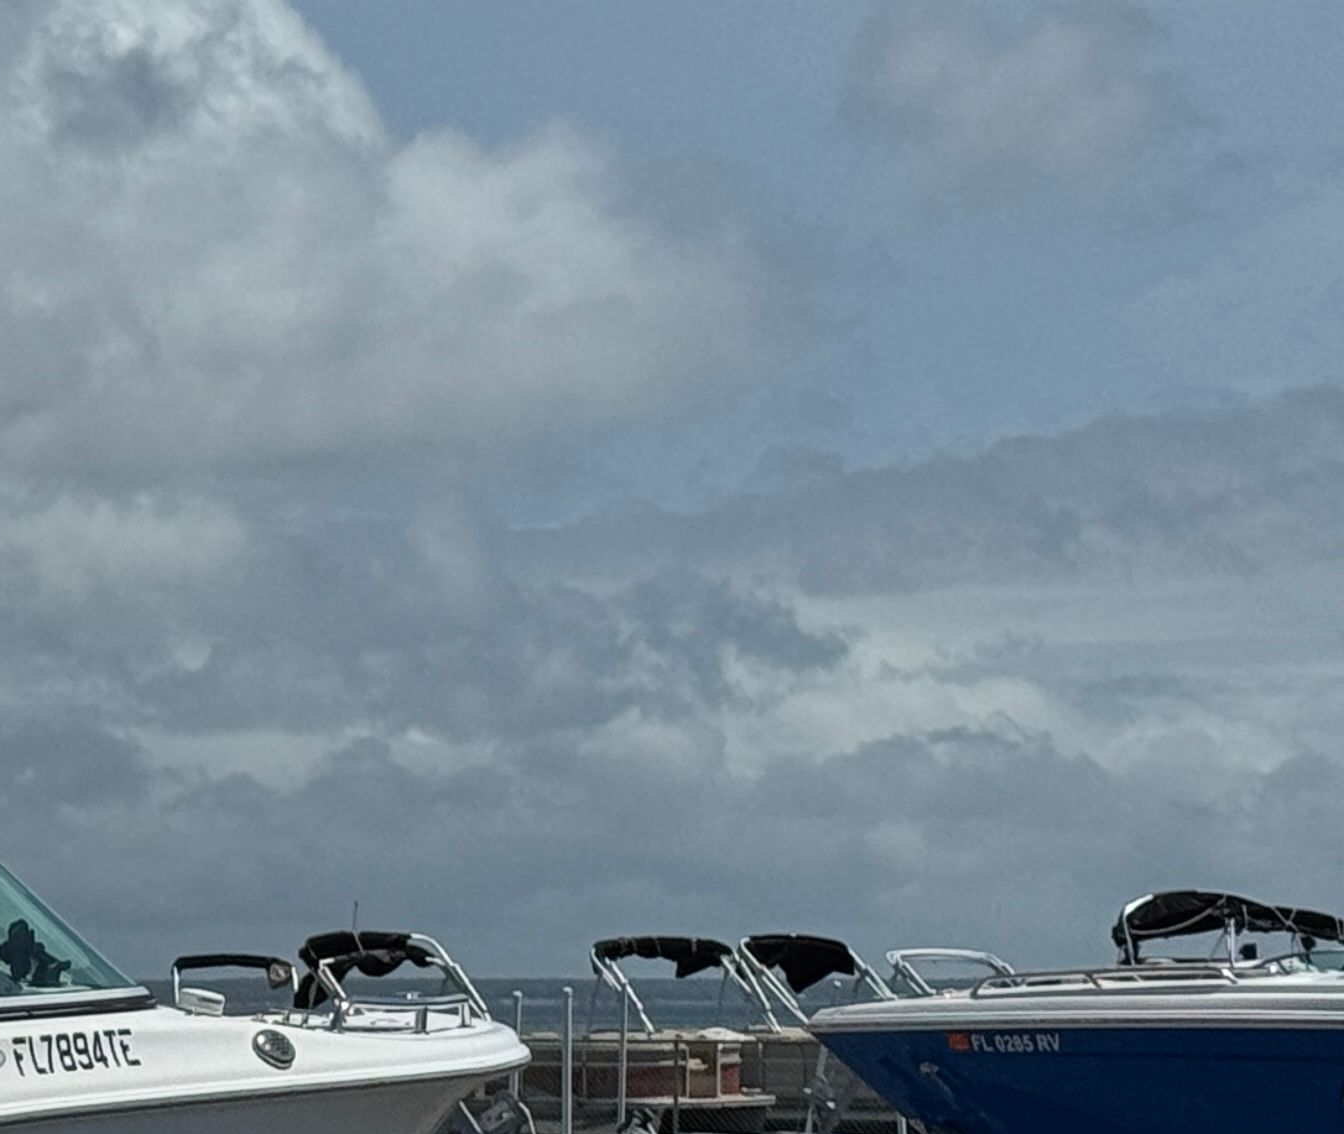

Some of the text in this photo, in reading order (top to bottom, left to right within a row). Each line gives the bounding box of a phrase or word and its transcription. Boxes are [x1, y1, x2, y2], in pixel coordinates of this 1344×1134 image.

[11, 1028, 142, 1077] FL7894TE
[970, 1032, 994, 1052] FL
[1035, 1032, 1060, 1053] RV
